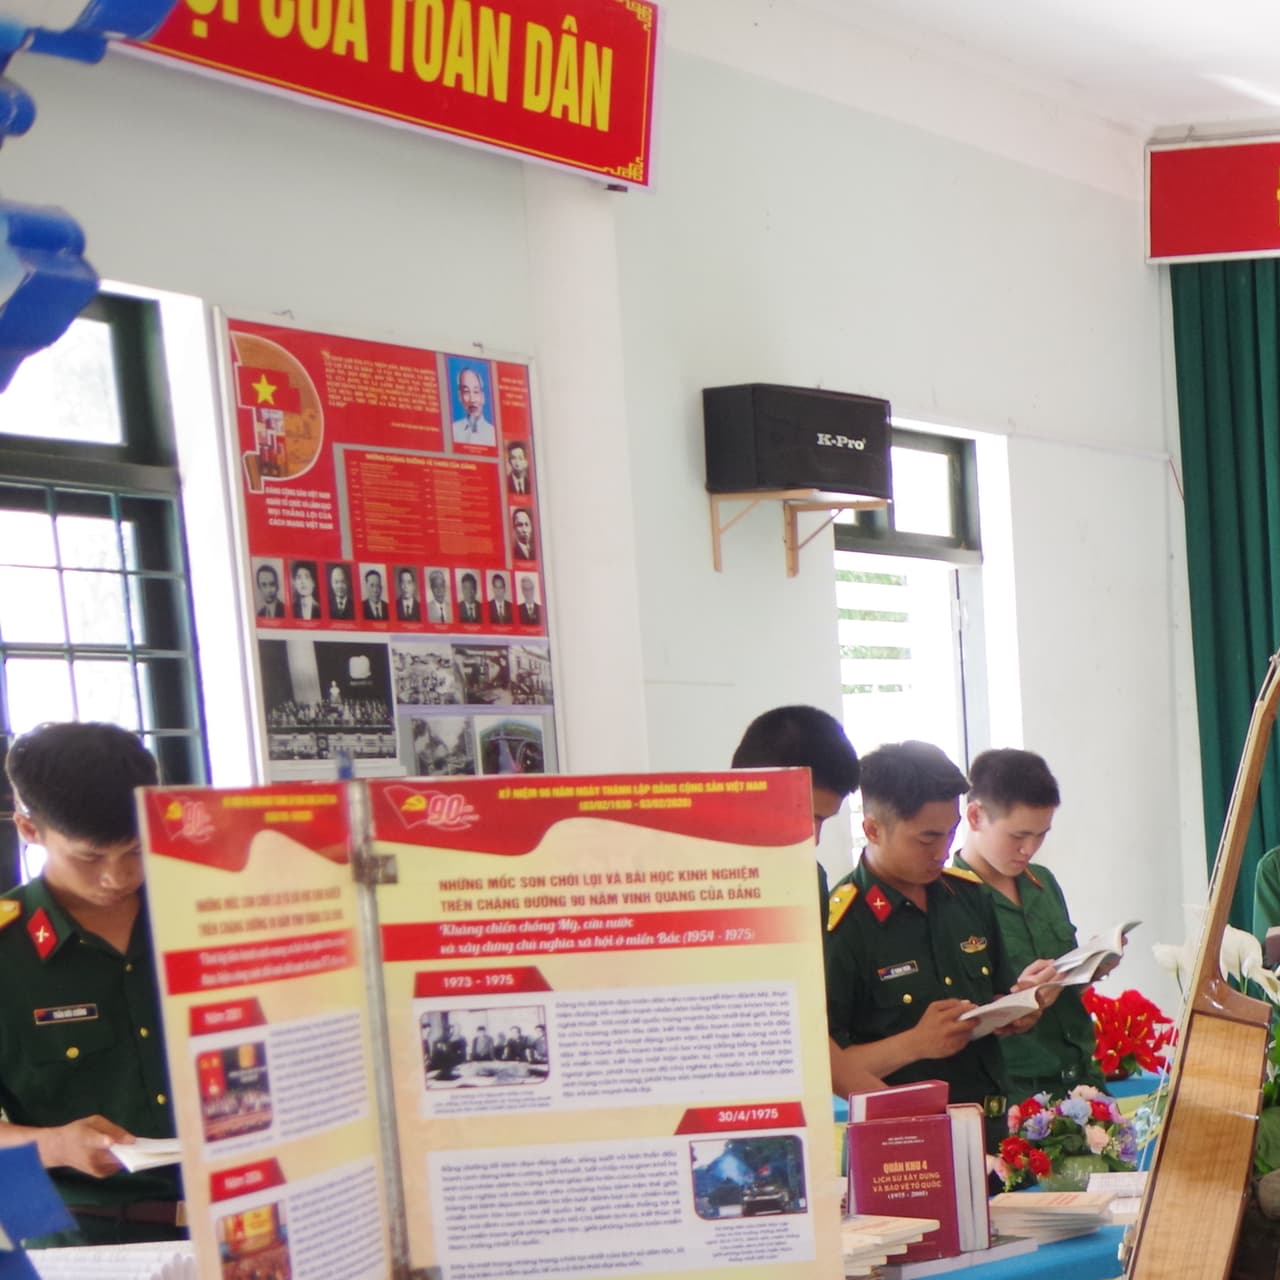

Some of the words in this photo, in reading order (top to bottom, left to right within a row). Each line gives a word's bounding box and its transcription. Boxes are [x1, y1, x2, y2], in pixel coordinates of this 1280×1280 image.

[523, 15, 613, 132] DÂN
[817, 432, 865, 451] K-Pro
[439, 876, 483, 892] NHỮNG
[488, 875, 515, 890] MỐC
[520, 875, 546, 888] SON
[550, 872, 580, 887] CHÓI
[583, 872, 601, 889] LỌI
[606, 869, 622, 885] VÀ
[626, 869, 646, 884] BÀI
[650, 868, 675, 885] HỌC
[678, 868, 707, 881] KINH
[712, 866, 760, 881] NGHIỆM
[441, 896, 473, 912] TRÊN
[477, 894, 520, 912] CHẶNG
[524, 893, 567, 909] ĐƯỜNG
[570, 894, 586, 907] 90
[590, 890, 618, 906] NĂM
[622, 890, 651, 904] VINH
[655, 887, 696, 904] QUANG
[699, 884, 724, 900] CỦA
[728, 883, 761, 899] ĐẢNG
[724, 926, 756, 943] 1975)
[442, 975, 473, 989] 1973
[485, 974, 514, 987] 1975
[718, 1108, 779, 1123] 30/4/1975
[905, 1160, 921, 1171] KHU
[920, 1179, 942, 1189] QUỐC
